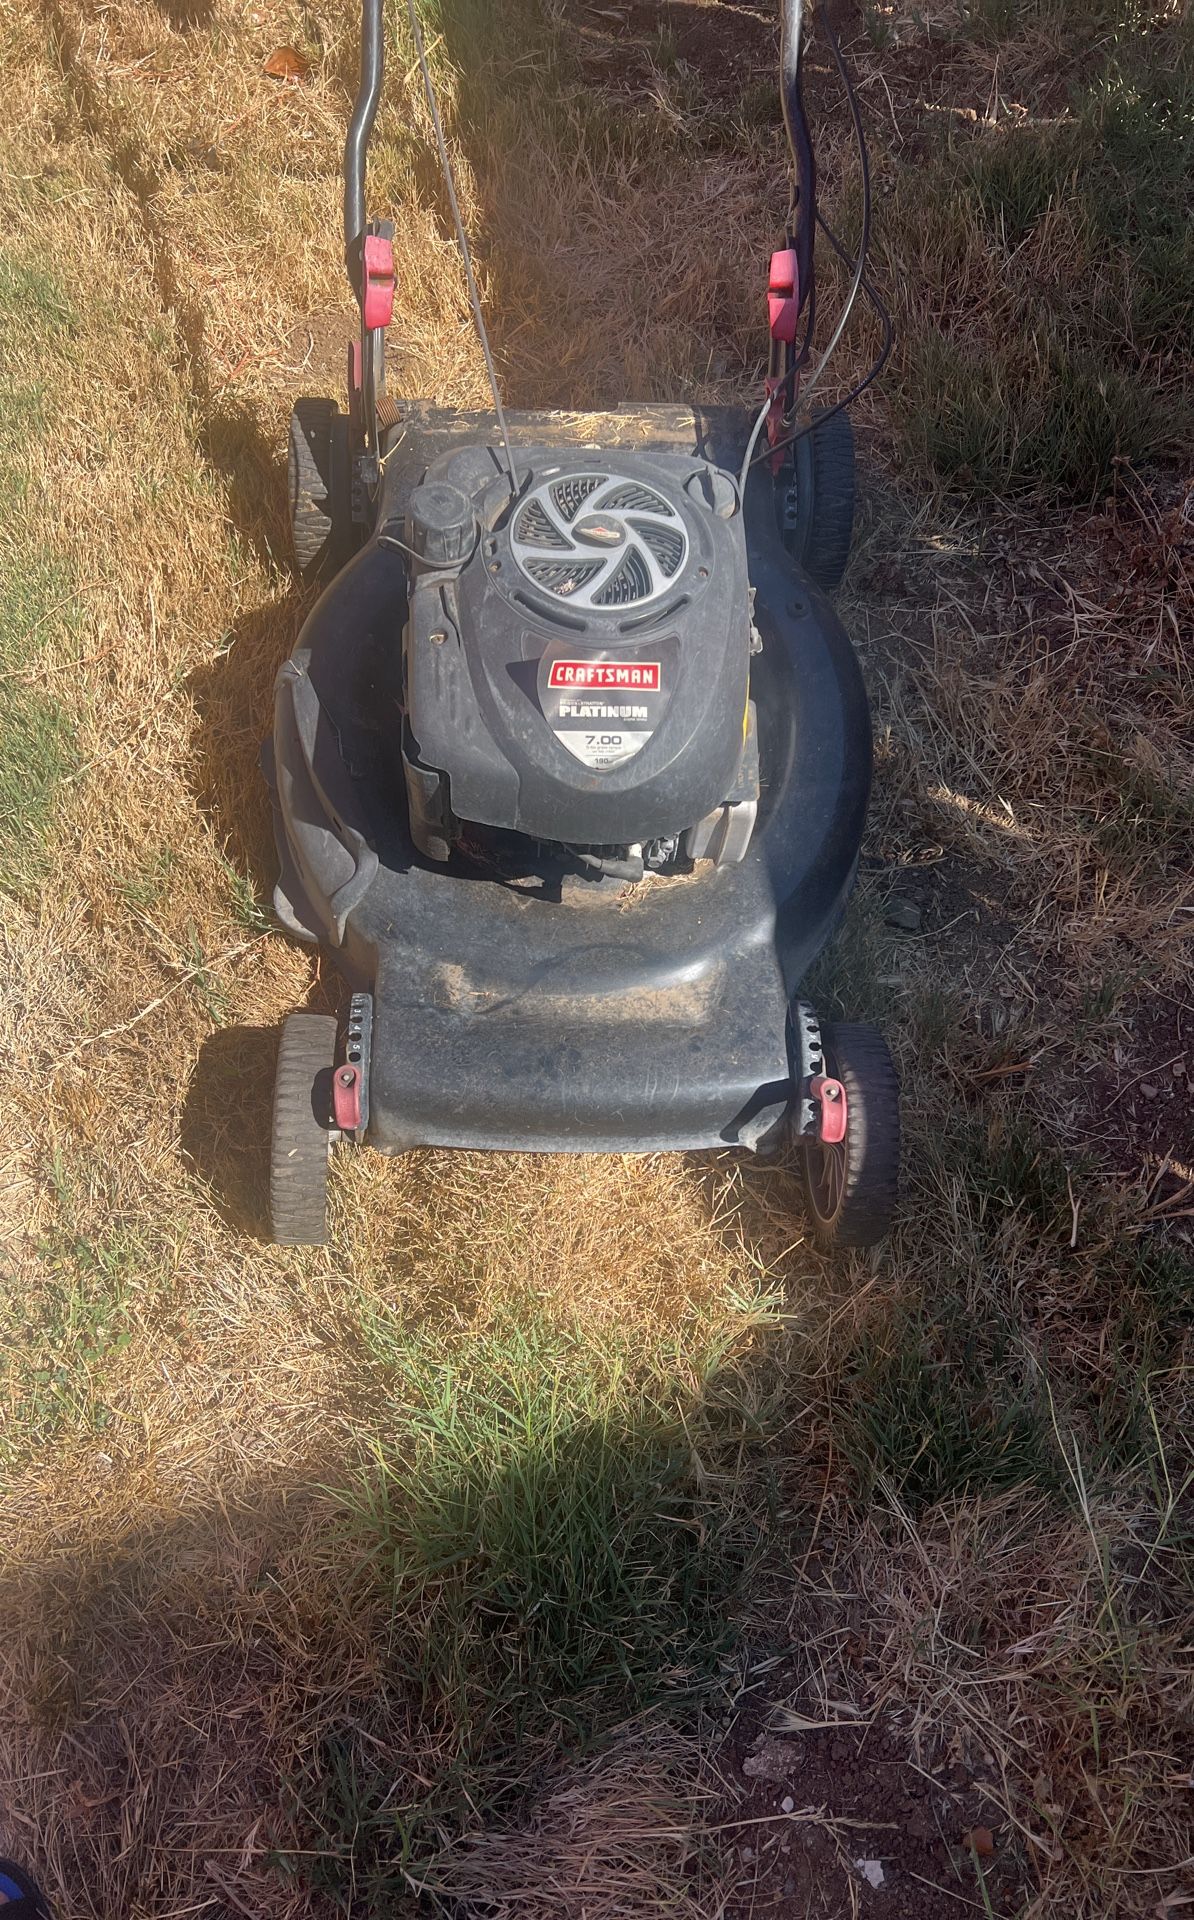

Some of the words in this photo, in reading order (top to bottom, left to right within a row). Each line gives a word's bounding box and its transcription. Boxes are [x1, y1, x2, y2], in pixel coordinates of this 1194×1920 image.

[556, 667, 653, 684] CRAFTSMAN
[559, 706, 648, 718] PLATINUM
[585, 735, 622, 745] 7.00
